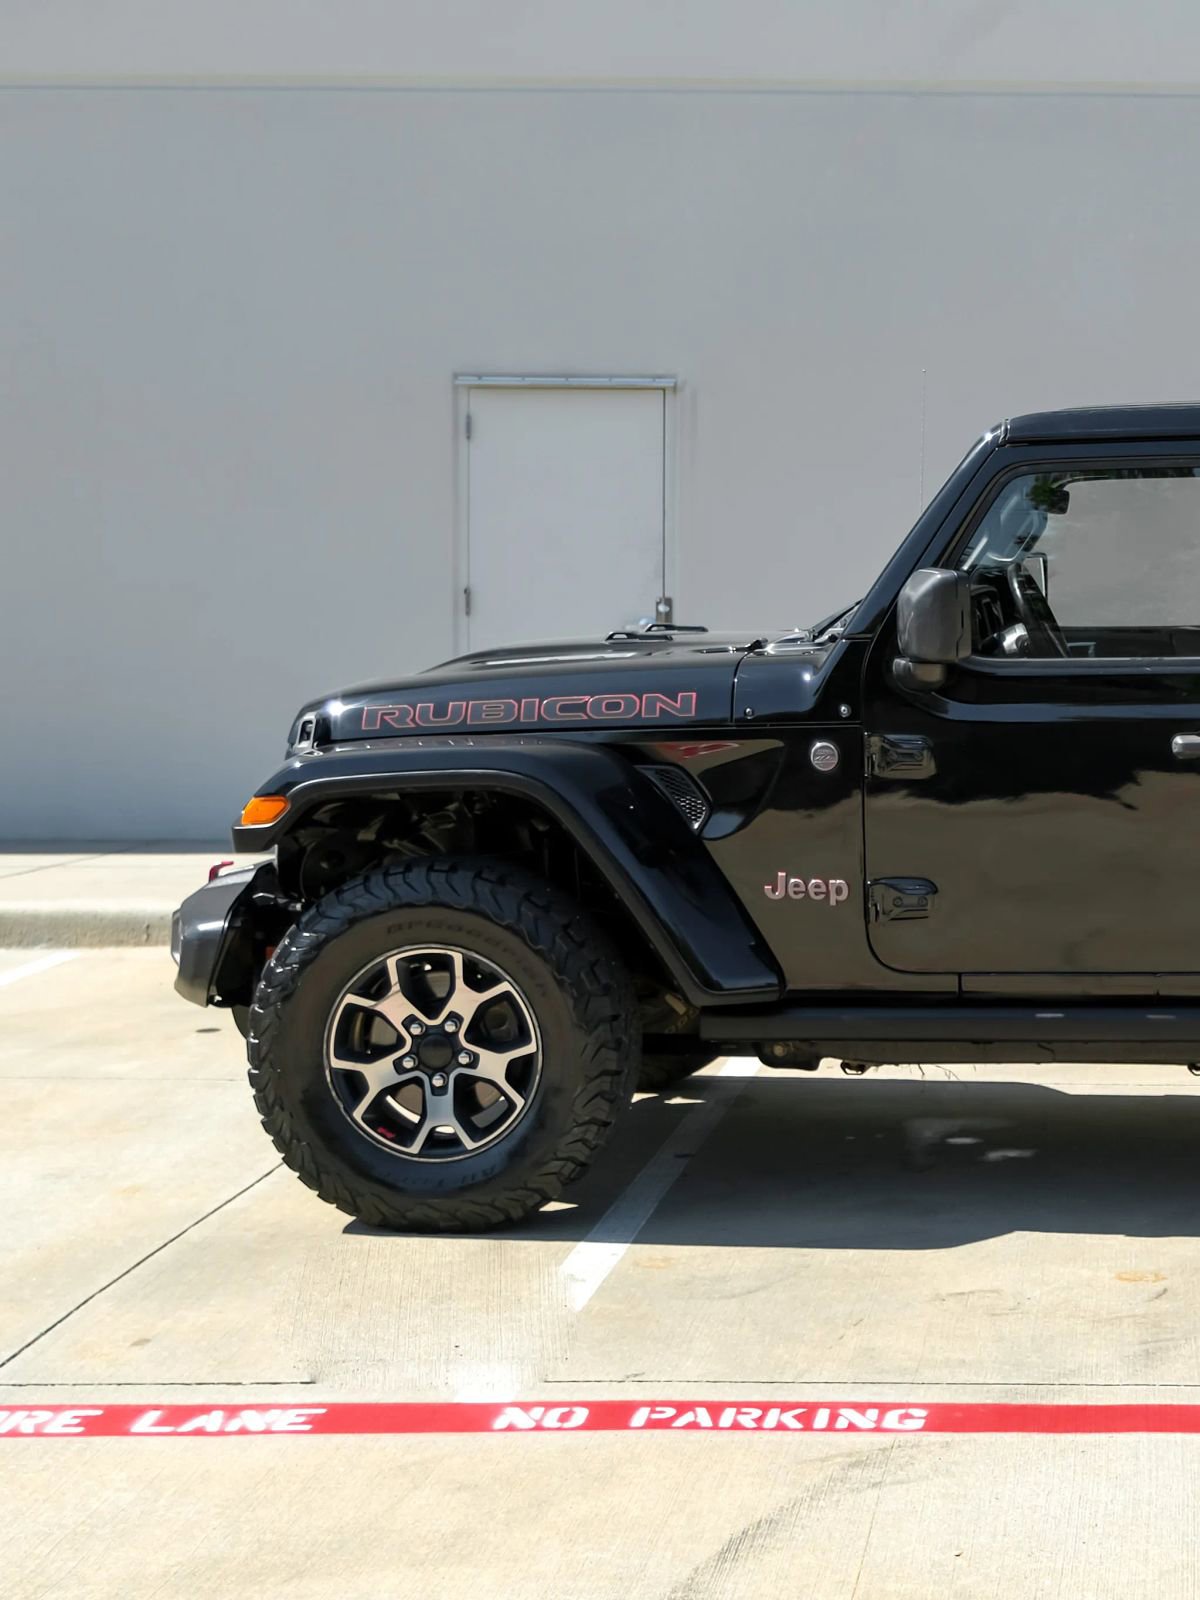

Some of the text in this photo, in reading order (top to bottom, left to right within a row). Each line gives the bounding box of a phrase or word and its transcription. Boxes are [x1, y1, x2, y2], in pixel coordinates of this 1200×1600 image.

[362, 692, 697, 730] RUBICON
[764, 871, 849, 906] Jeep
[130, 1408, 328, 1432] LANE
[493, 1405, 928, 1430] NO PARKING
